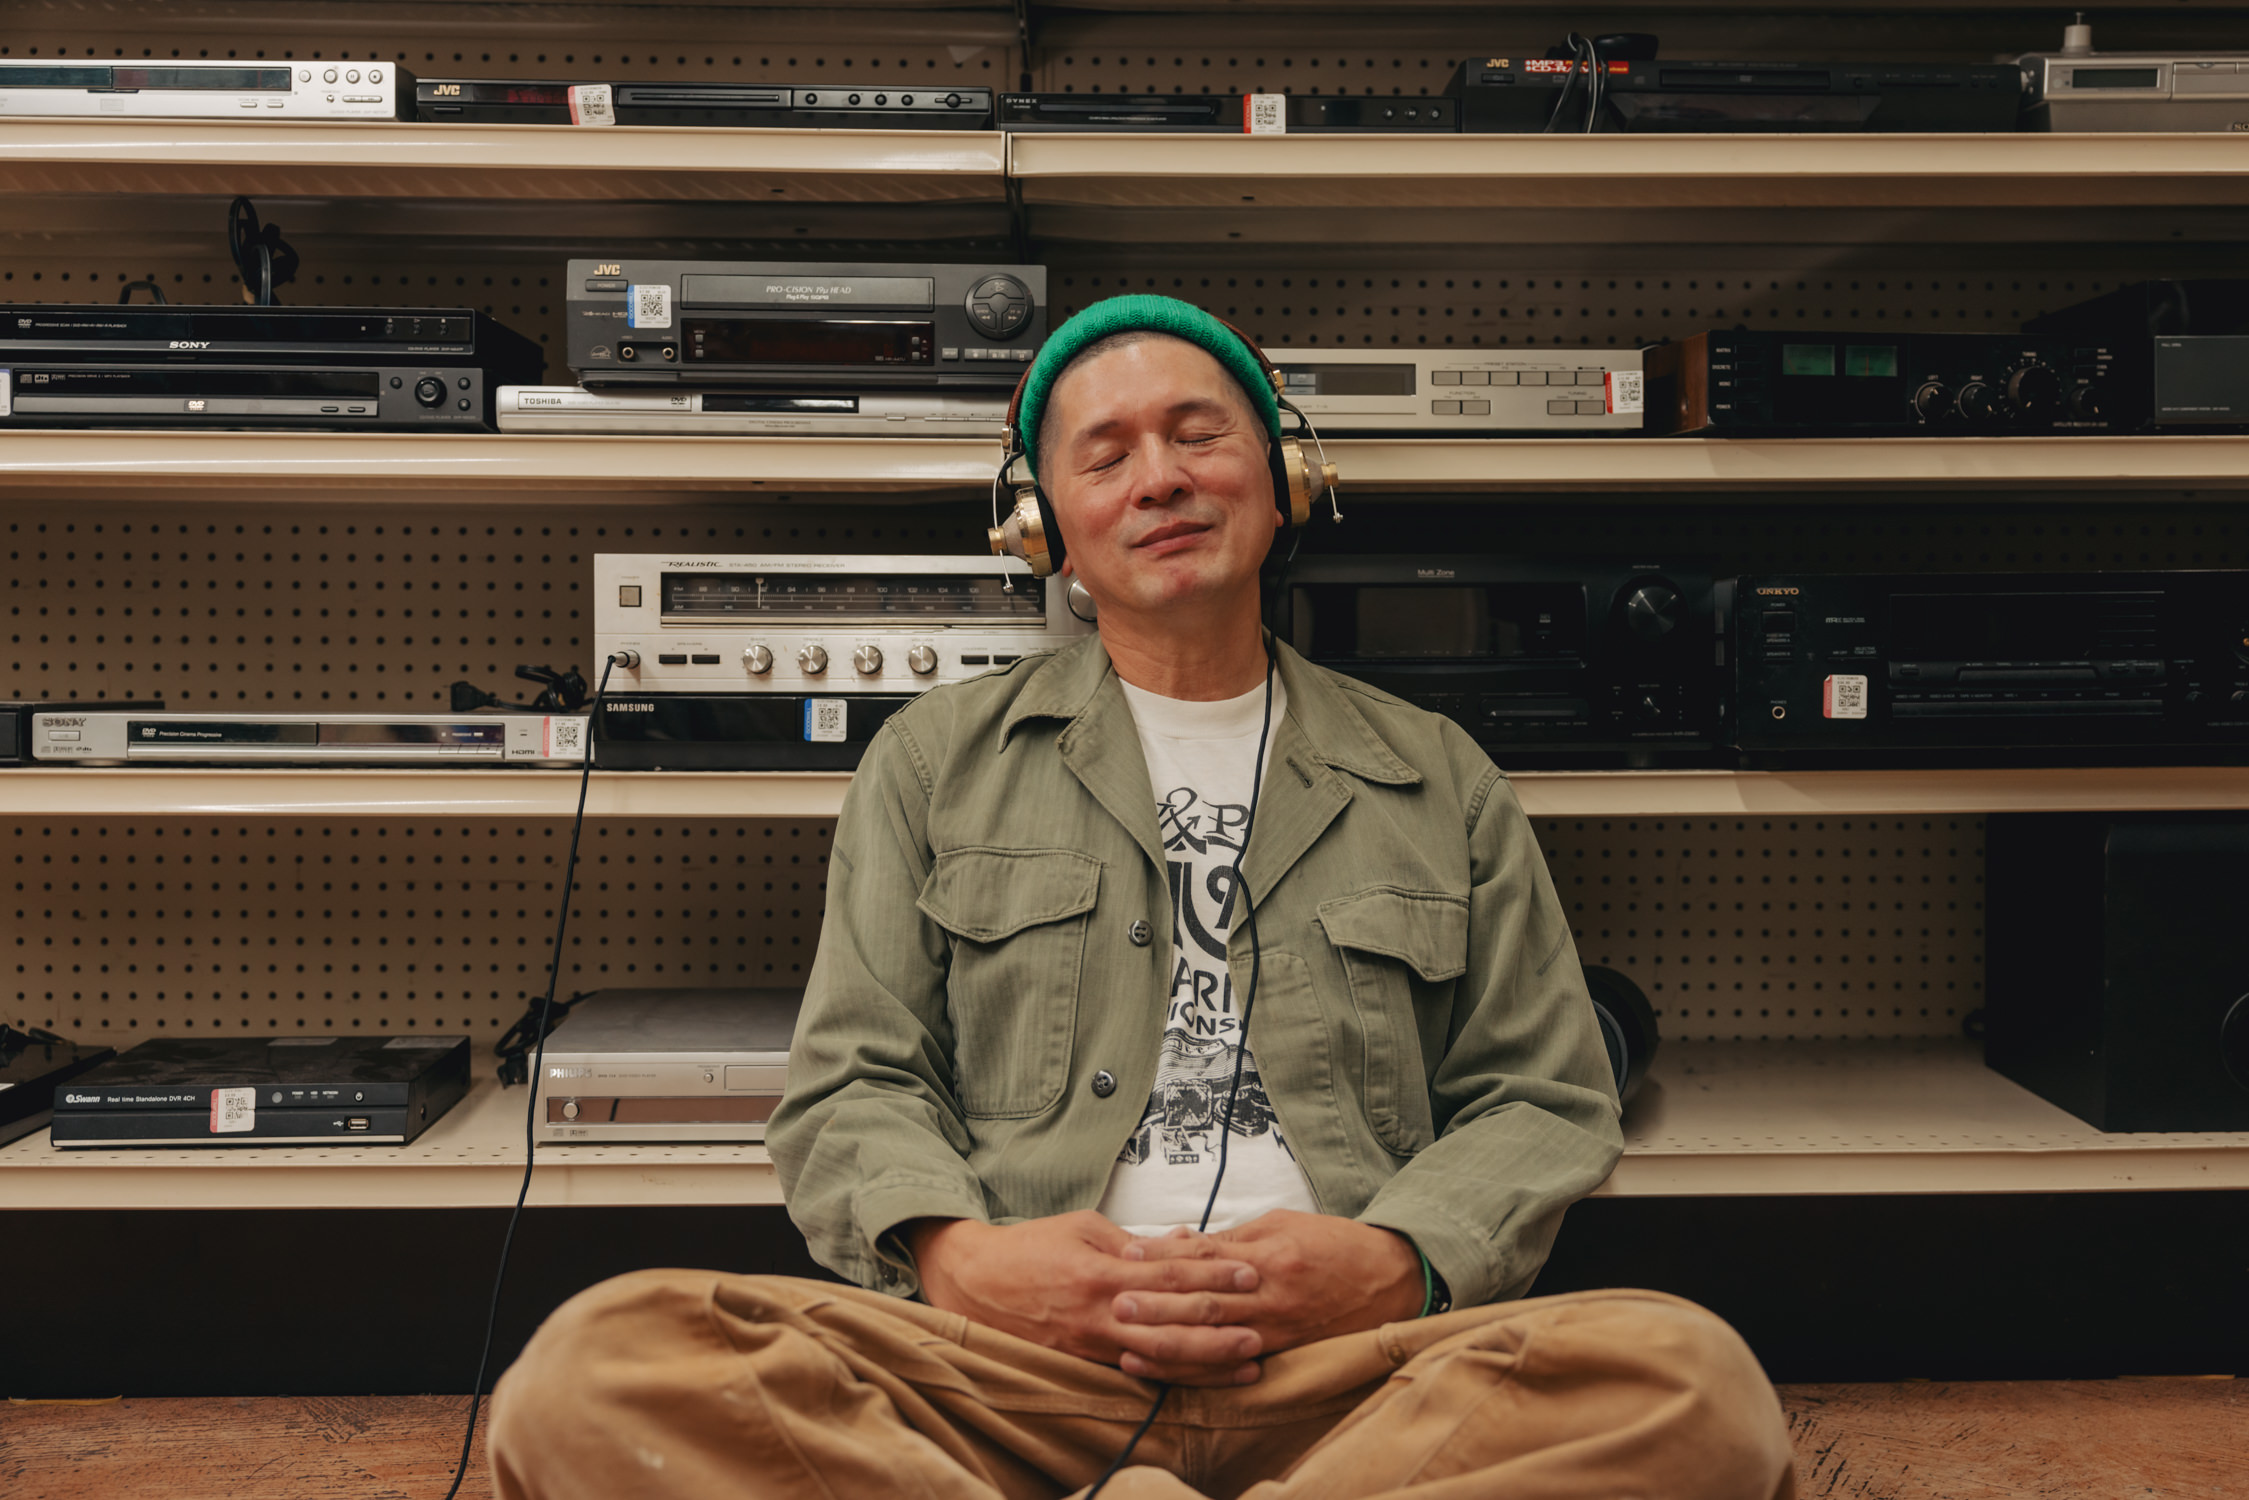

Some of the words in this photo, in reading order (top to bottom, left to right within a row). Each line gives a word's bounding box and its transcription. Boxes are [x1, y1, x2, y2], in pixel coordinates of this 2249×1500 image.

[1486, 58, 1510, 69] JVC
[433, 84, 461, 97] JVC
[594, 264, 621, 276] JVC
[829, 286, 852, 294] HEAD
[169, 341, 211, 349] SONY
[1417, 568, 1435, 577] Multi
[1436, 568, 1455, 577] Zone
[1756, 587, 1799, 595] ONKYO
[606, 703, 656, 713] SAMSUNG
[42, 717, 88, 728] SONY
[1167, 1001, 1244, 1036] IONS
[549, 1067, 592, 1079] PHILIPS
[76, 1094, 101, 1104] Swann
